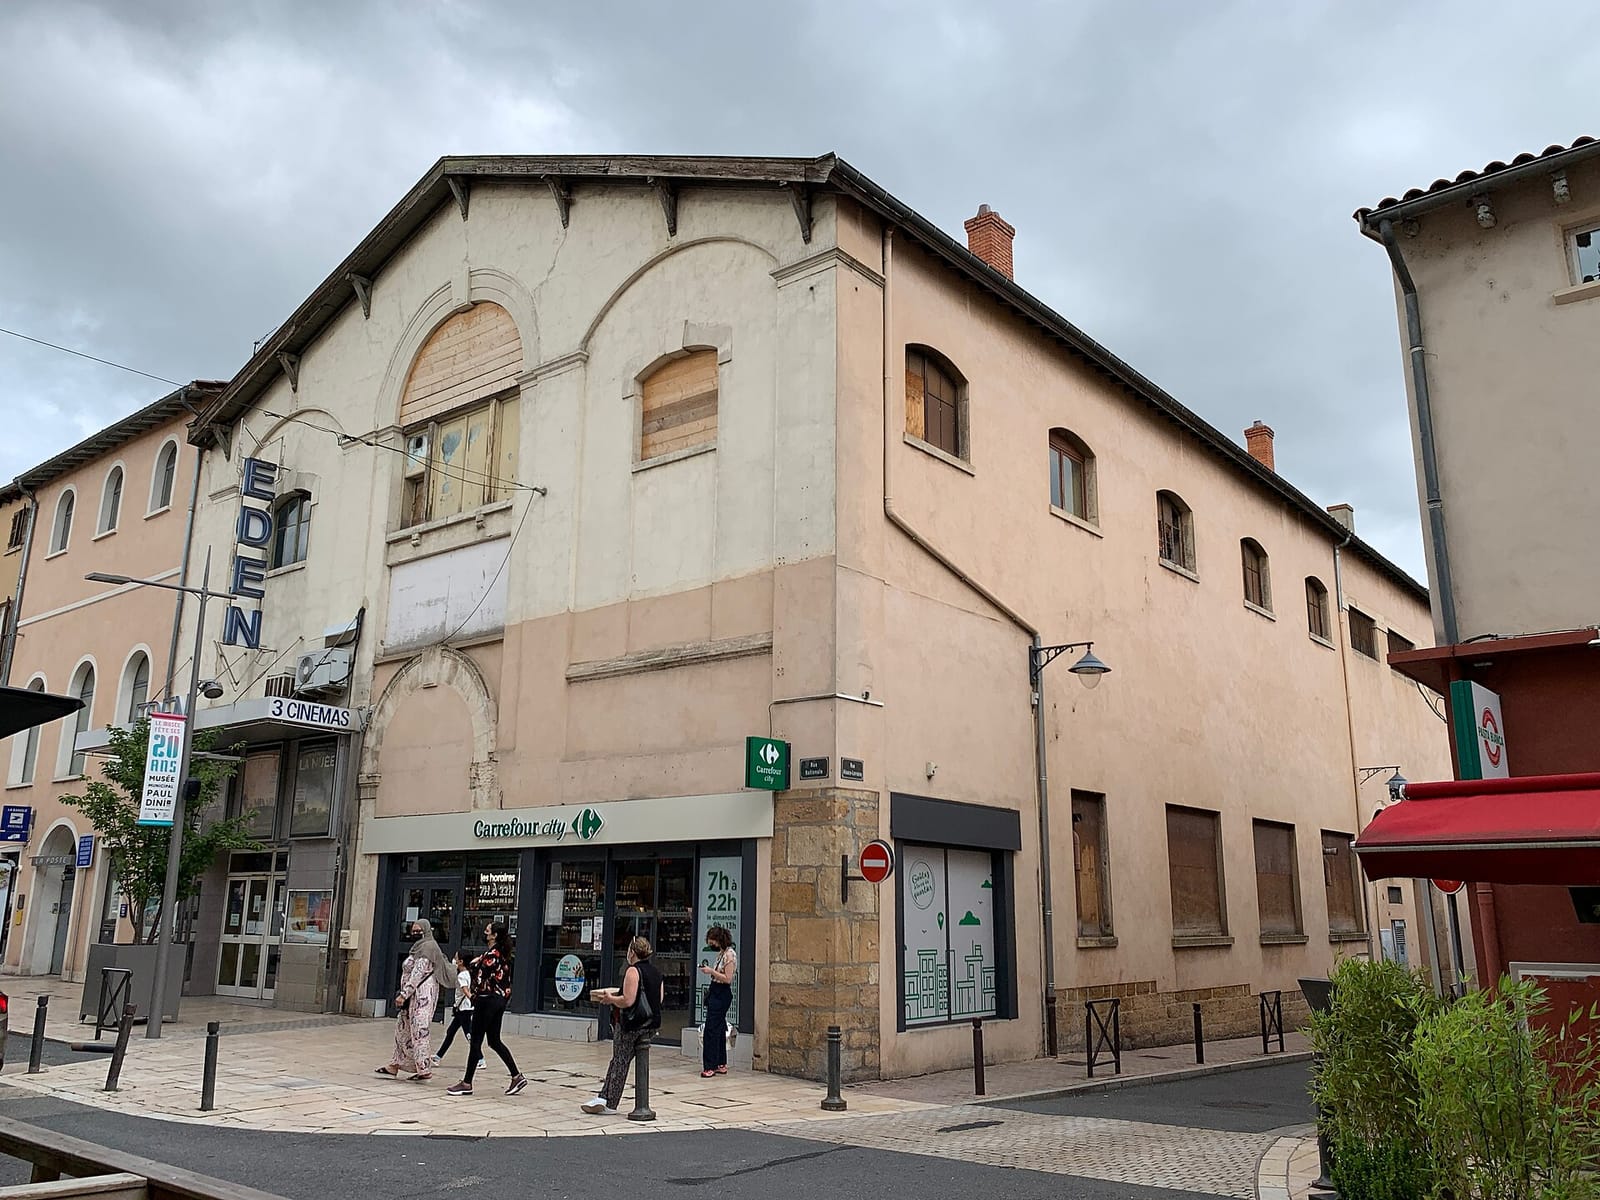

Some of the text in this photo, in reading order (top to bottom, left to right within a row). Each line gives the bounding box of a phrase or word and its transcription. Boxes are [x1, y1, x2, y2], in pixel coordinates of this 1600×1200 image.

[223, 457, 277, 649] EDEN
[272, 700, 350, 727] 3 CINEMAS
[152, 734, 179, 759] 20
[149, 775, 175, 783] MUSÉE
[756, 765, 782, 776] Carrefour
[764, 774, 774, 785] city
[147, 789, 172, 798] PAUL
[474, 817, 567, 841] Carrefour city
[480, 872, 516, 882] les horaires
[708, 870, 738, 891] 7h à
[707, 893, 737, 911] 22h
